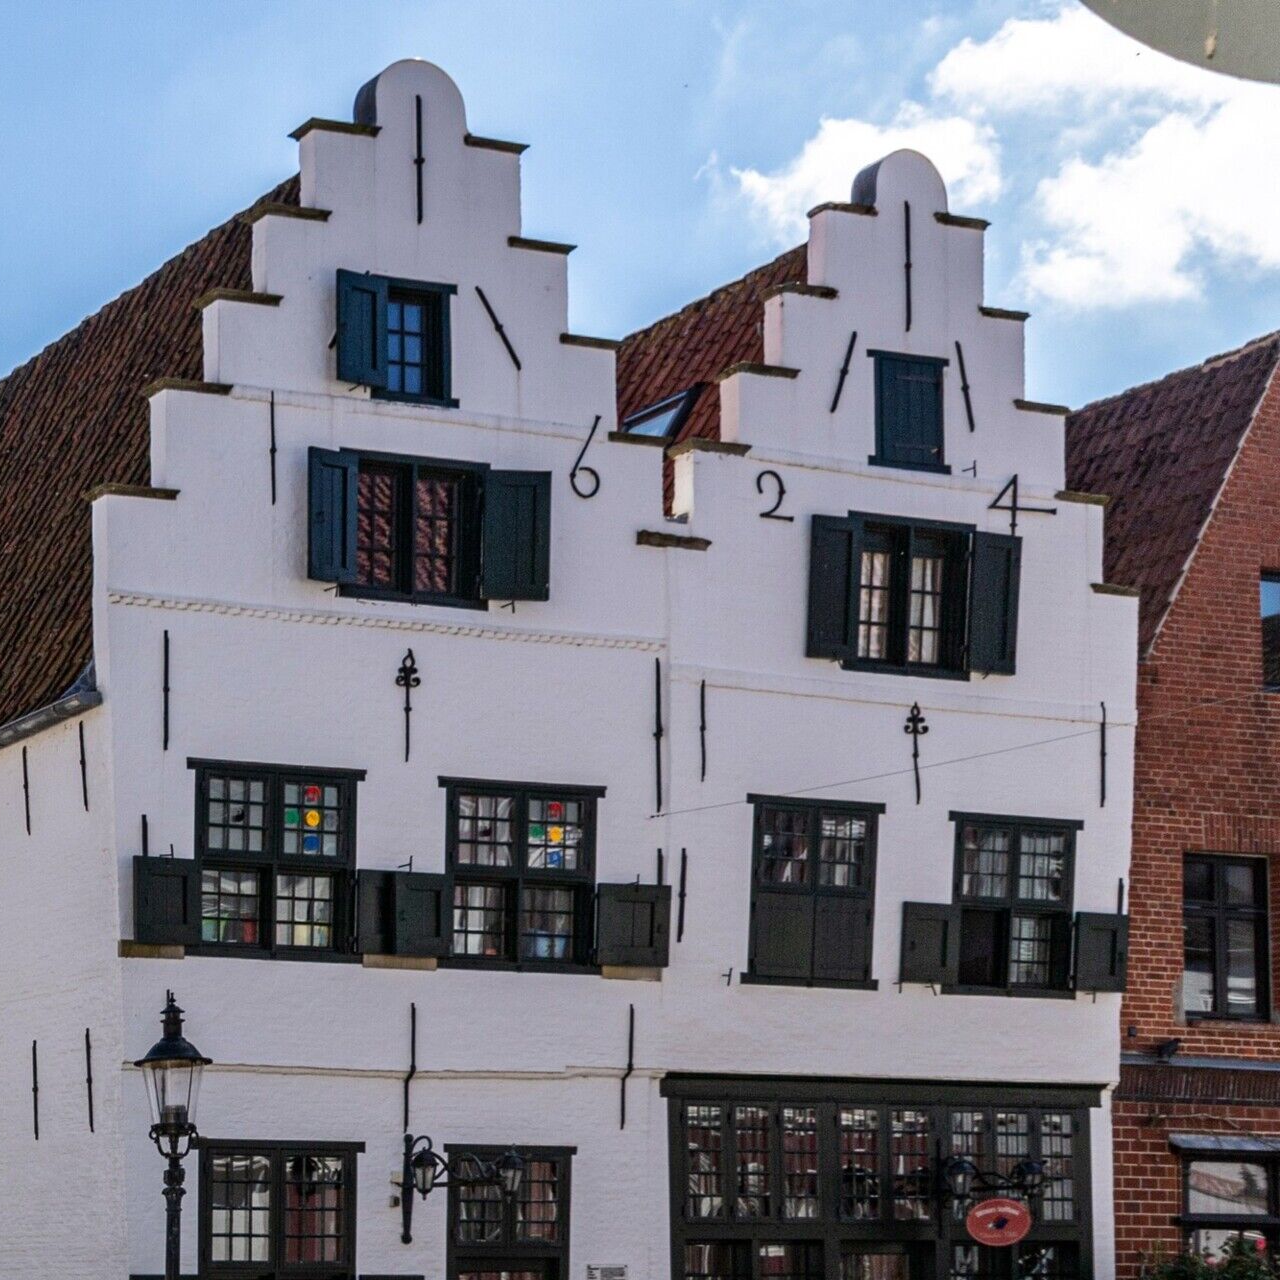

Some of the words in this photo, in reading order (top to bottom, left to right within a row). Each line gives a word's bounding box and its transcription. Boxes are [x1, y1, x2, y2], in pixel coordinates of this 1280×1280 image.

[569, 414, 602, 499] 6
[755, 469, 795, 522] 2
[988, 474, 1058, 536] 4
